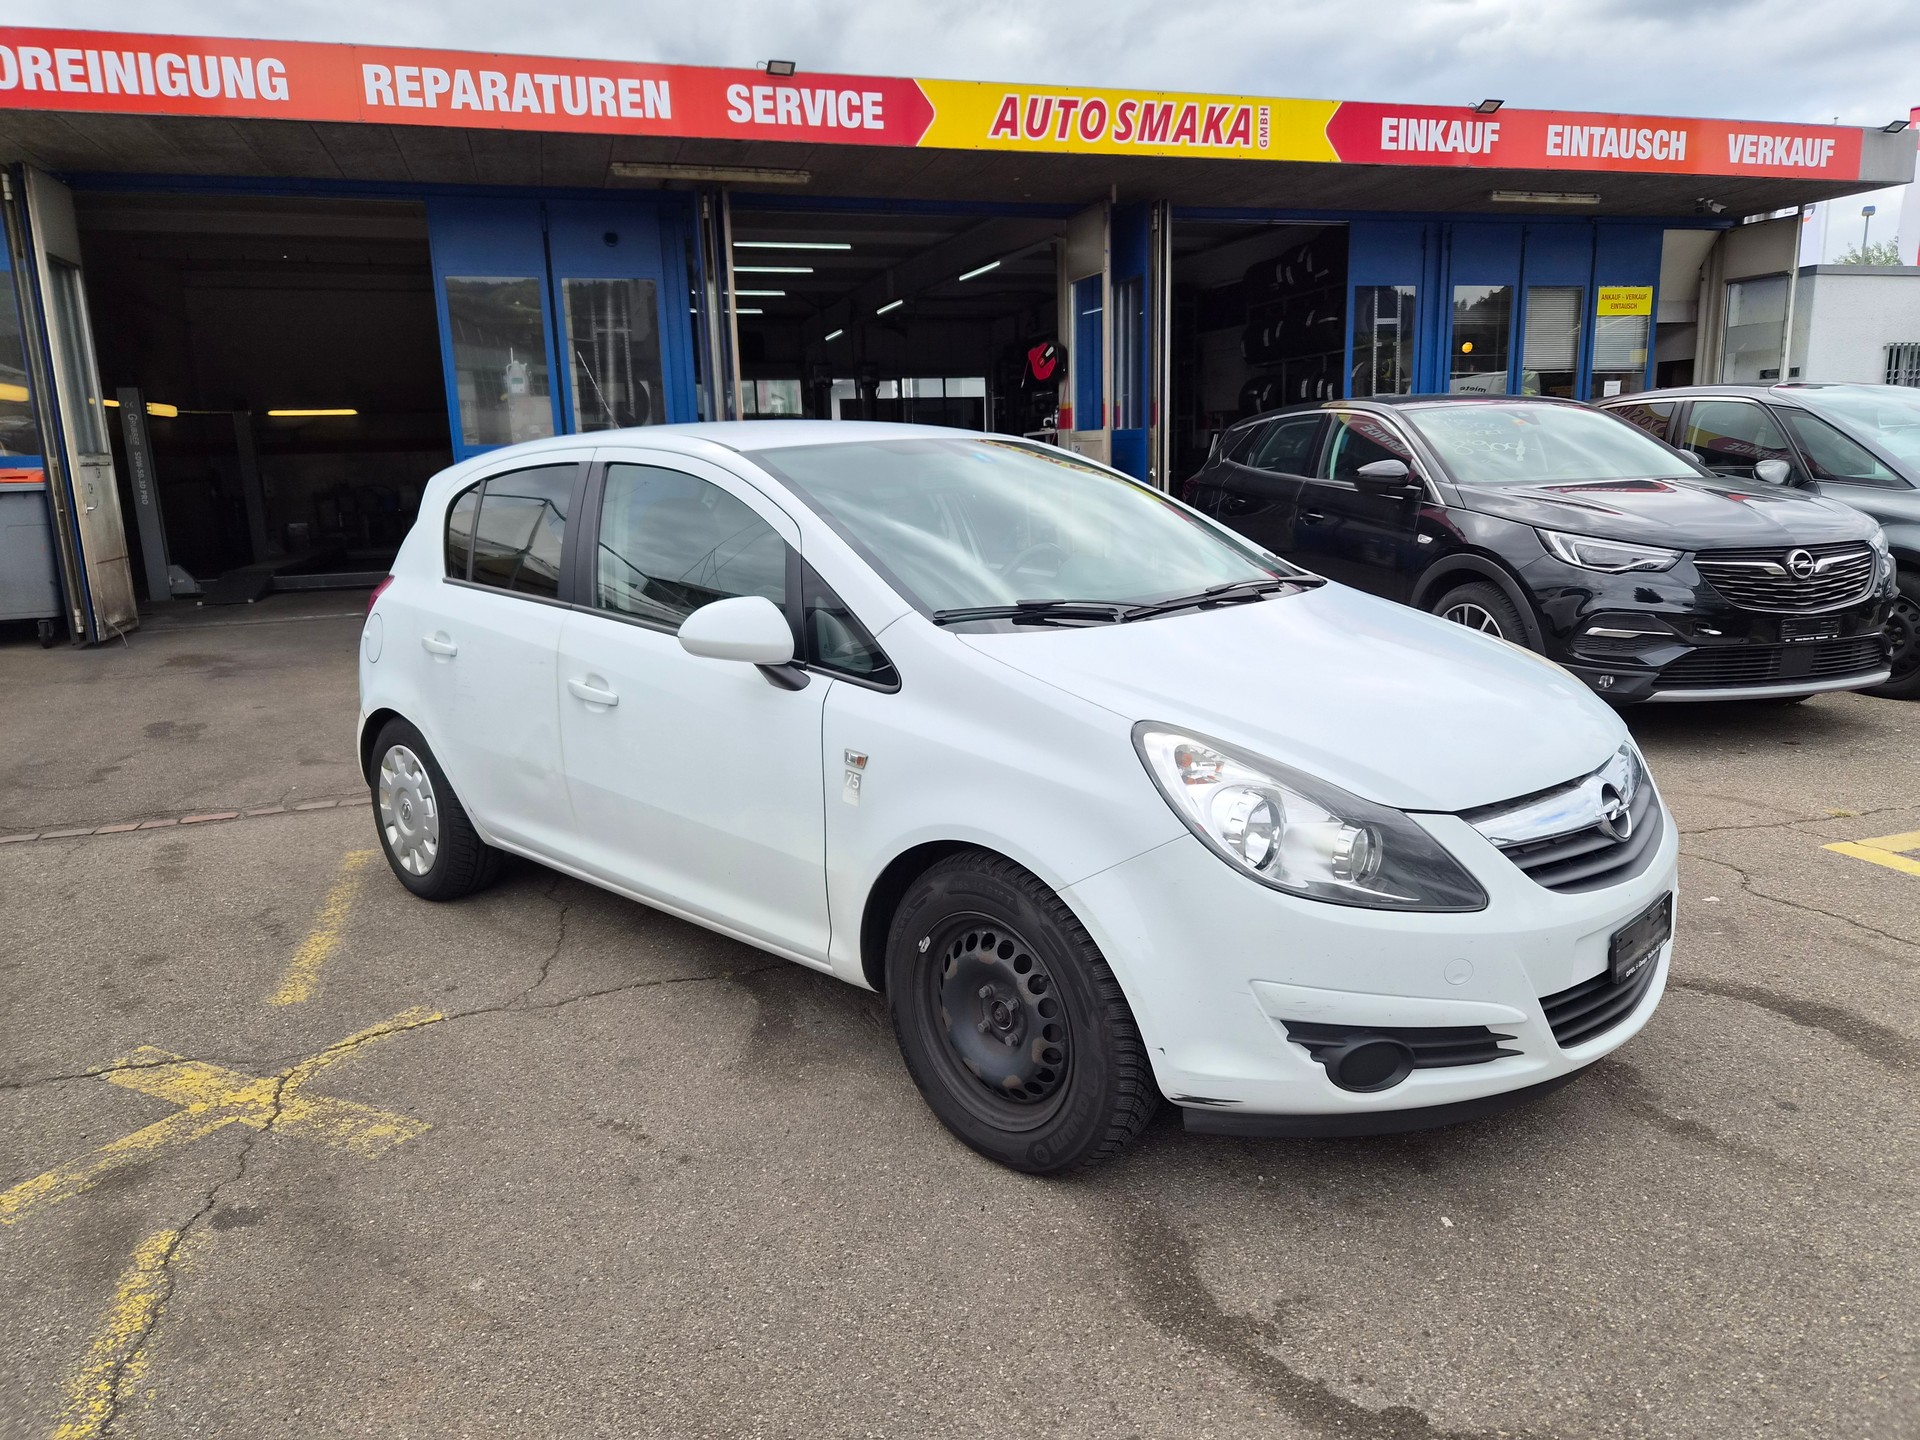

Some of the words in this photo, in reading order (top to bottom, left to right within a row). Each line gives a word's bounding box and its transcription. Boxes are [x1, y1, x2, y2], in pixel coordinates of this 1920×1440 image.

[361, 63, 672, 120] REPARATUREN
[726, 83, 885, 131] SERVICE
[988, 94, 1109, 143] AUTO
[1111, 99, 1254, 148] SMAKA
[1259, 106, 1269, 149] GMBH
[1381, 117, 1500, 154] EINKAUF
[1546, 124, 1687, 161] EINTAUSCH
[1728, 133, 1836, 168] VERKAUF
[1610, 302, 1638, 310] EINTAUSCH
[846, 771, 860, 789] 75
